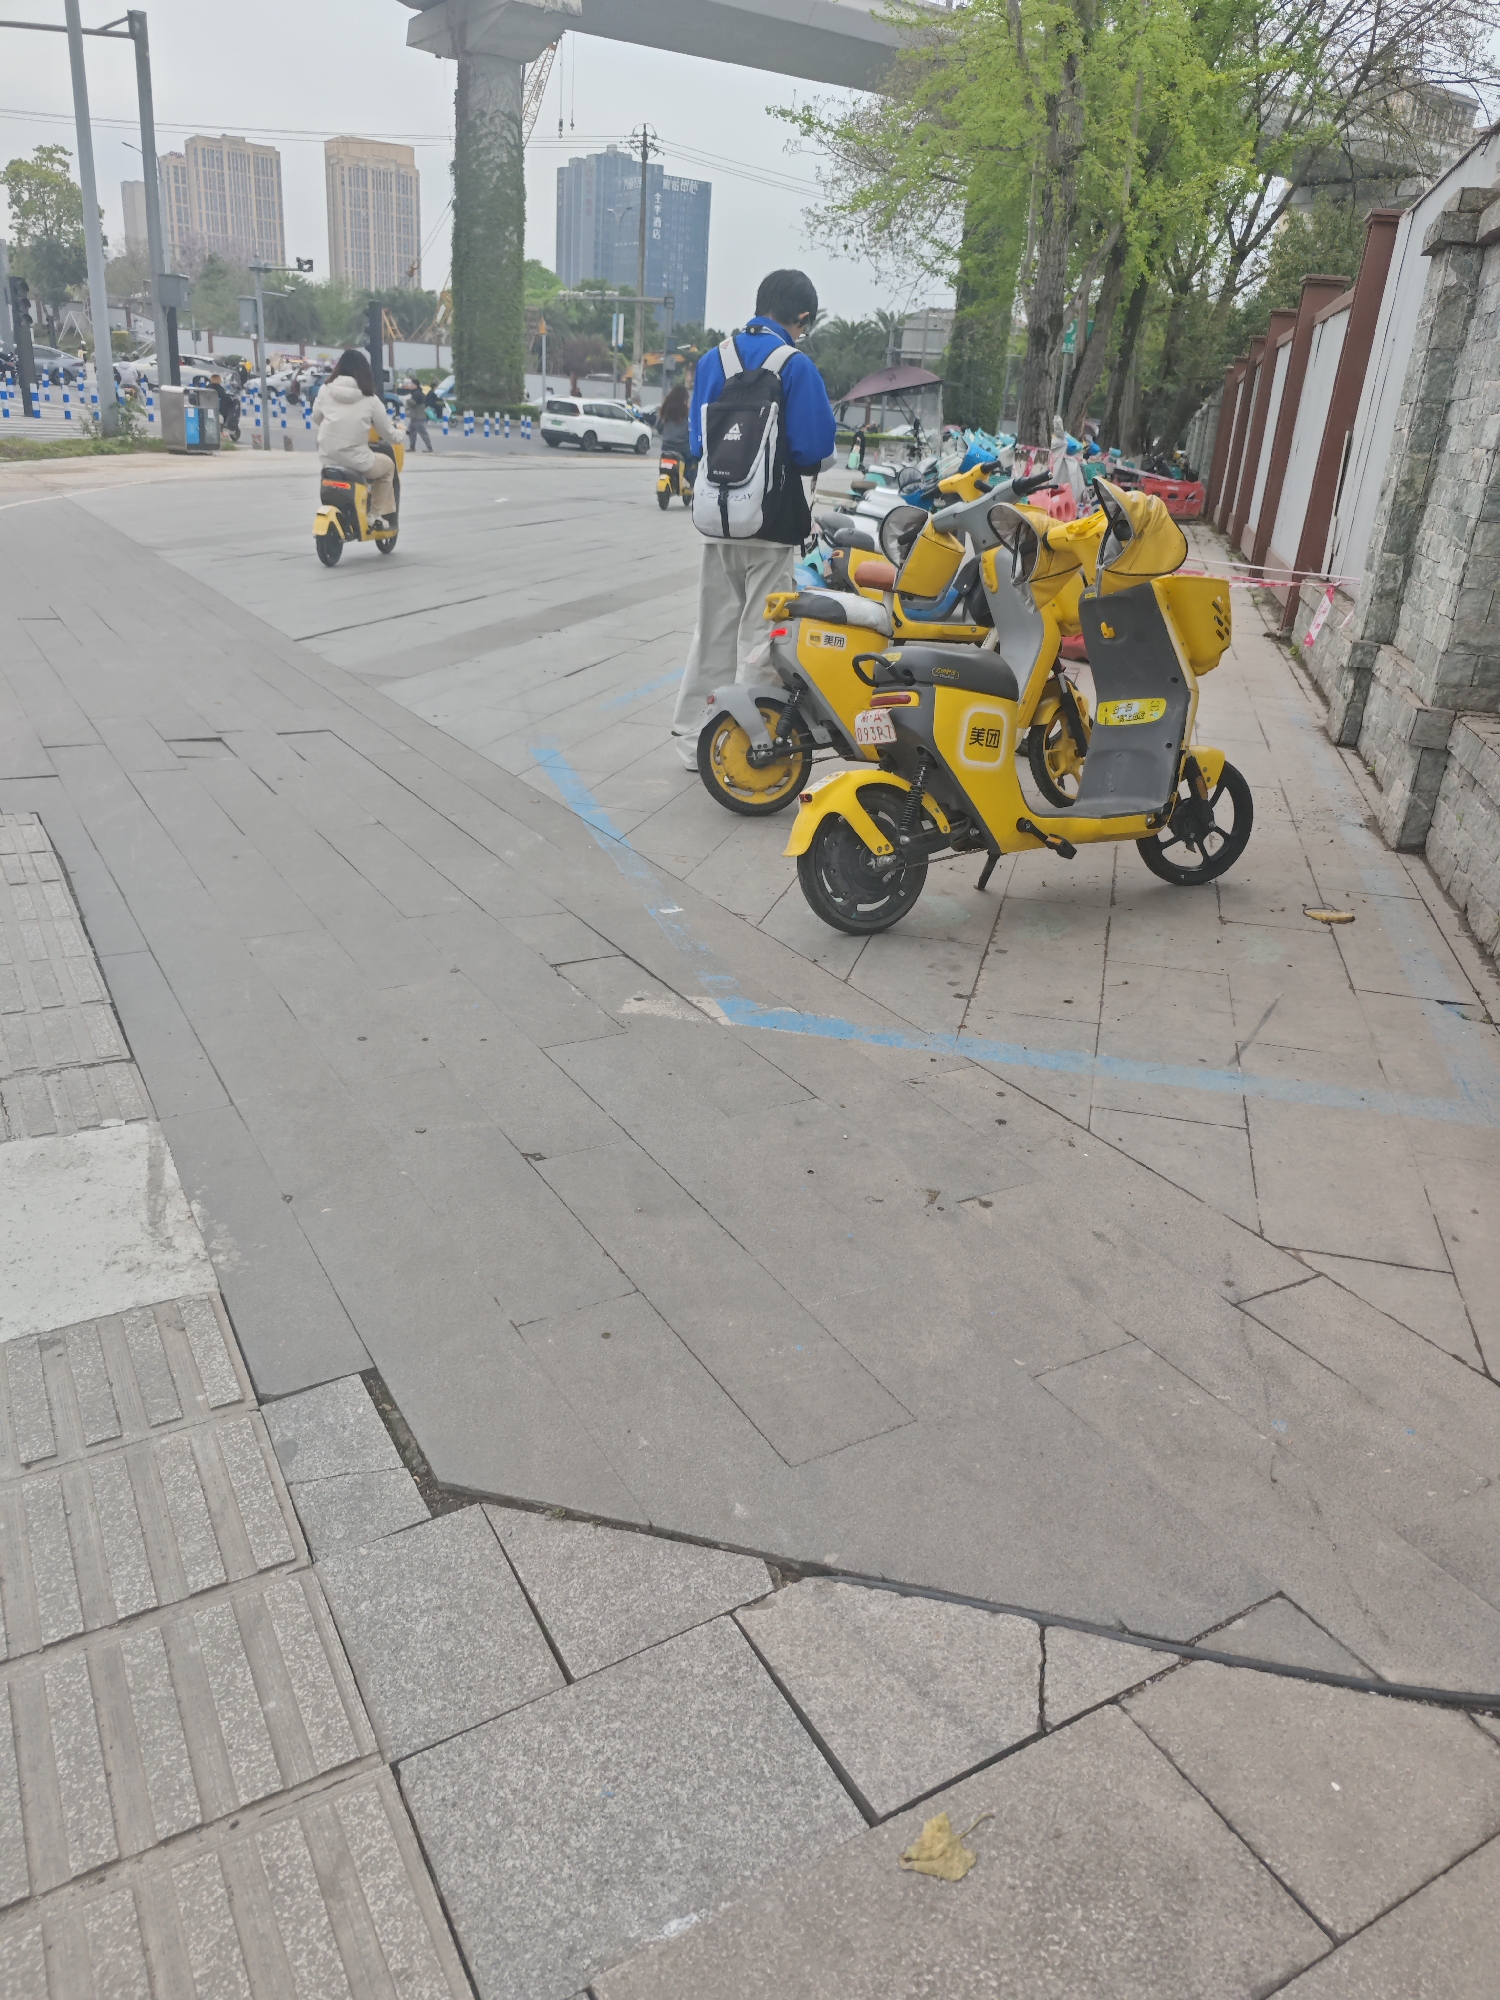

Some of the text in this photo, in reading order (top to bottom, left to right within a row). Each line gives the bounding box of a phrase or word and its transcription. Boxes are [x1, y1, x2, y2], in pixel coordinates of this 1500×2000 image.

[652, 192, 662, 240] 全季酒店
[723, 433, 743, 441] PEAK
[823, 634, 845, 648] 美团
[968, 726, 1001, 749] 美团
